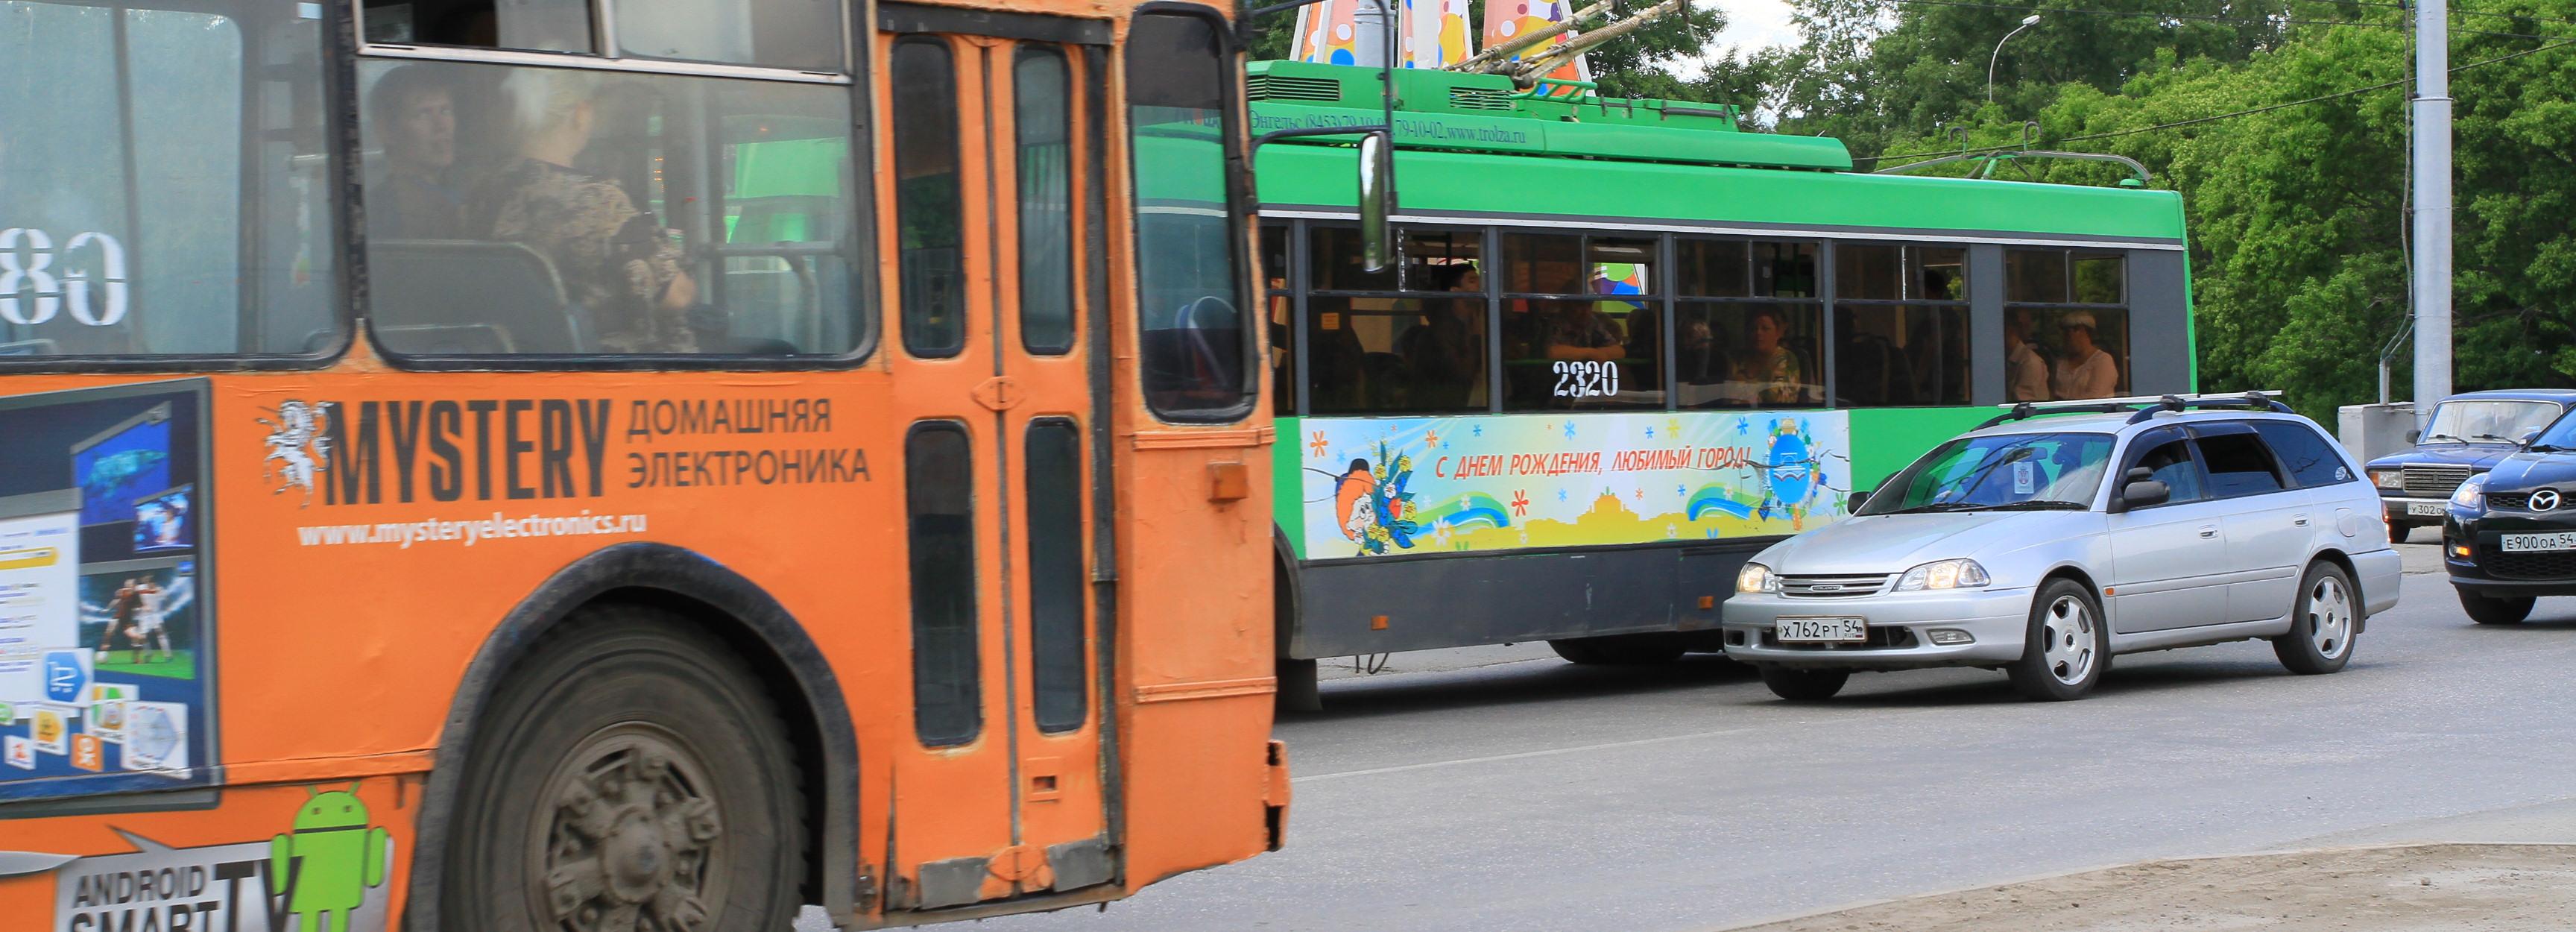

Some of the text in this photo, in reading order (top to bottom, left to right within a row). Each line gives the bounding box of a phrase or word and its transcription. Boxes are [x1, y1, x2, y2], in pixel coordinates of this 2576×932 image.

[1553, 360, 1619, 397] 2320
[627, 398, 833, 444] ДОМАШНЯЯ
[324, 398, 613, 506] MYSTERY
[627, 448, 872, 488] ЭЛЕКТРОНИКА
[1453, 454, 1504, 480] ДНЕМ
[1509, 451, 1603, 476] РОЖДЕНИЯ,
[1611, 445, 1692, 472] ЛЮБИМЫЙ
[1696, 446, 1752, 470] ГОРОД!
[297, 509, 648, 549] www.mysteryelectronics.ru
[72, 863, 207, 909] ANDROID
